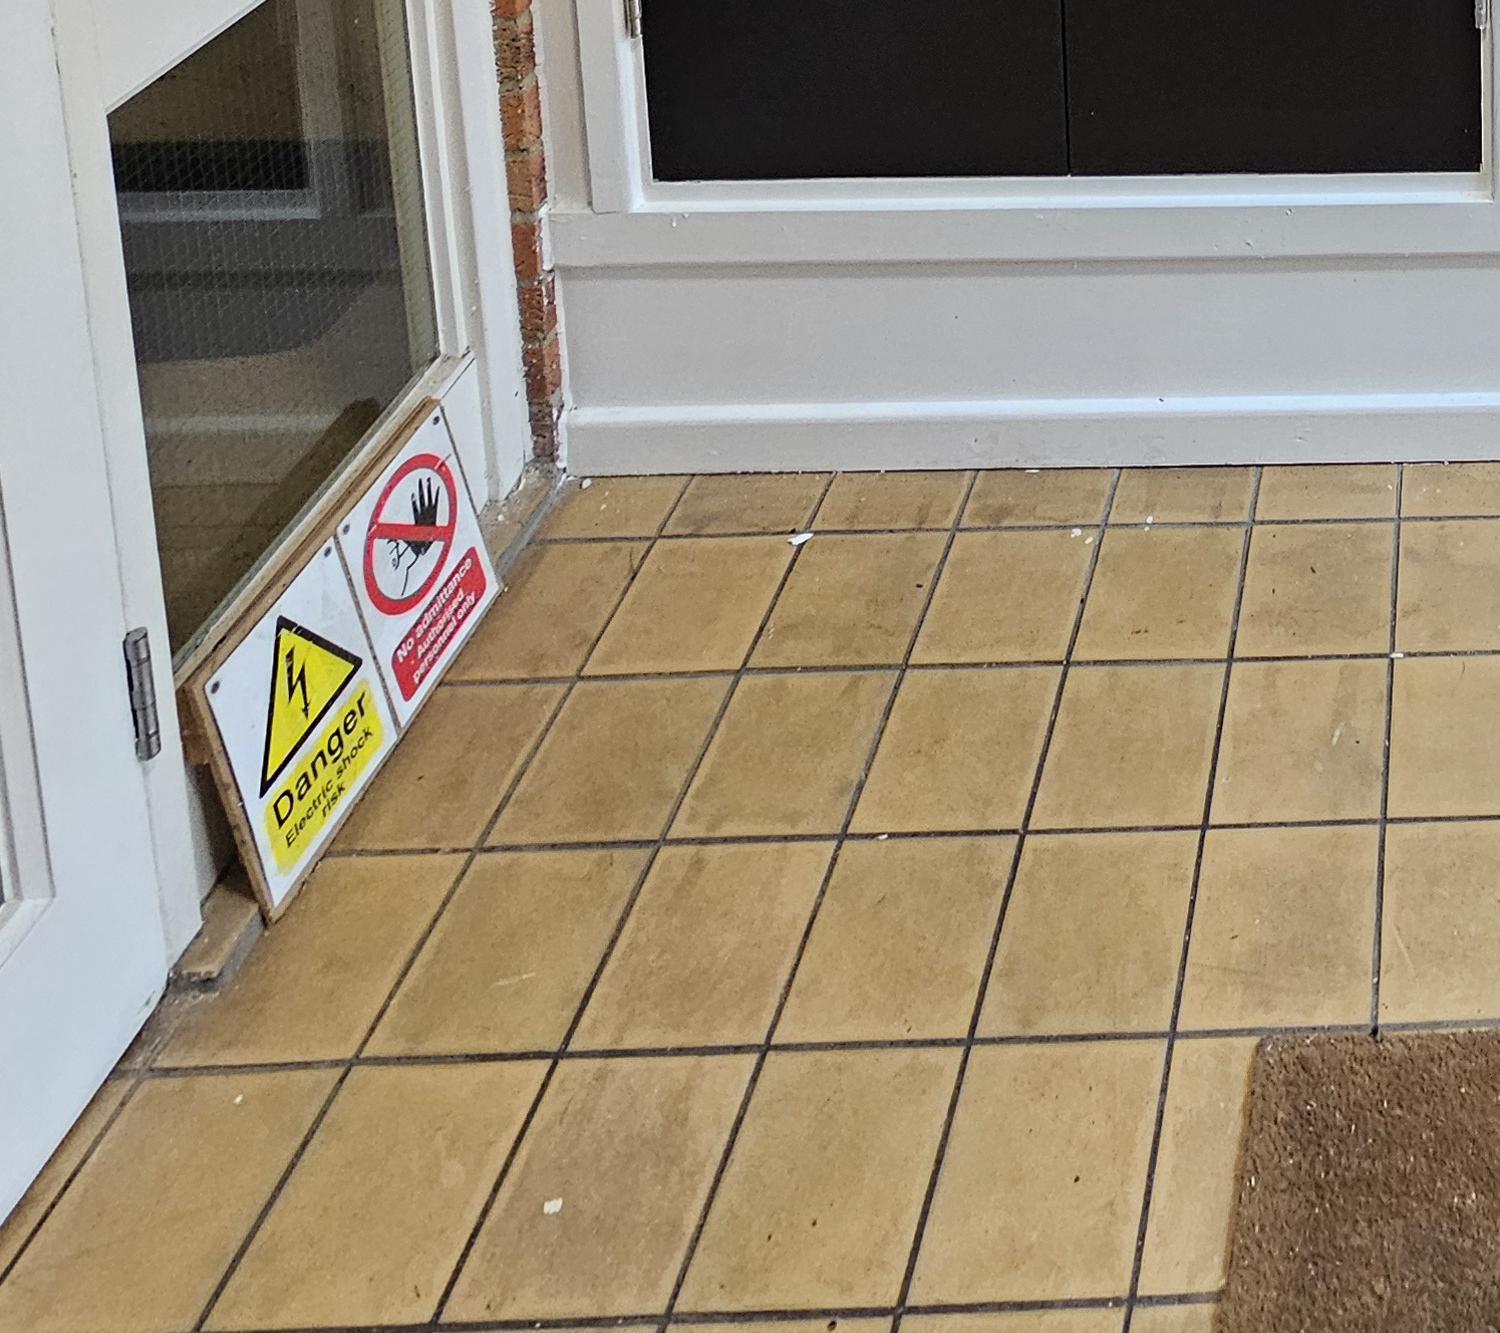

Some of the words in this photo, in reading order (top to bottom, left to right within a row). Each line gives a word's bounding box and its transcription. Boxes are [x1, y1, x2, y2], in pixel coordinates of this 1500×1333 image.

[396, 636, 415, 663] No
[415, 557, 473, 639] admittance
[416, 587, 466, 659] Authorised
[457, 590, 477, 620] only
[272, 691, 366, 830] Danger
[284, 778, 334, 849] Electric
[335, 726, 374, 779] shock
[321, 781, 347, 818] risk
